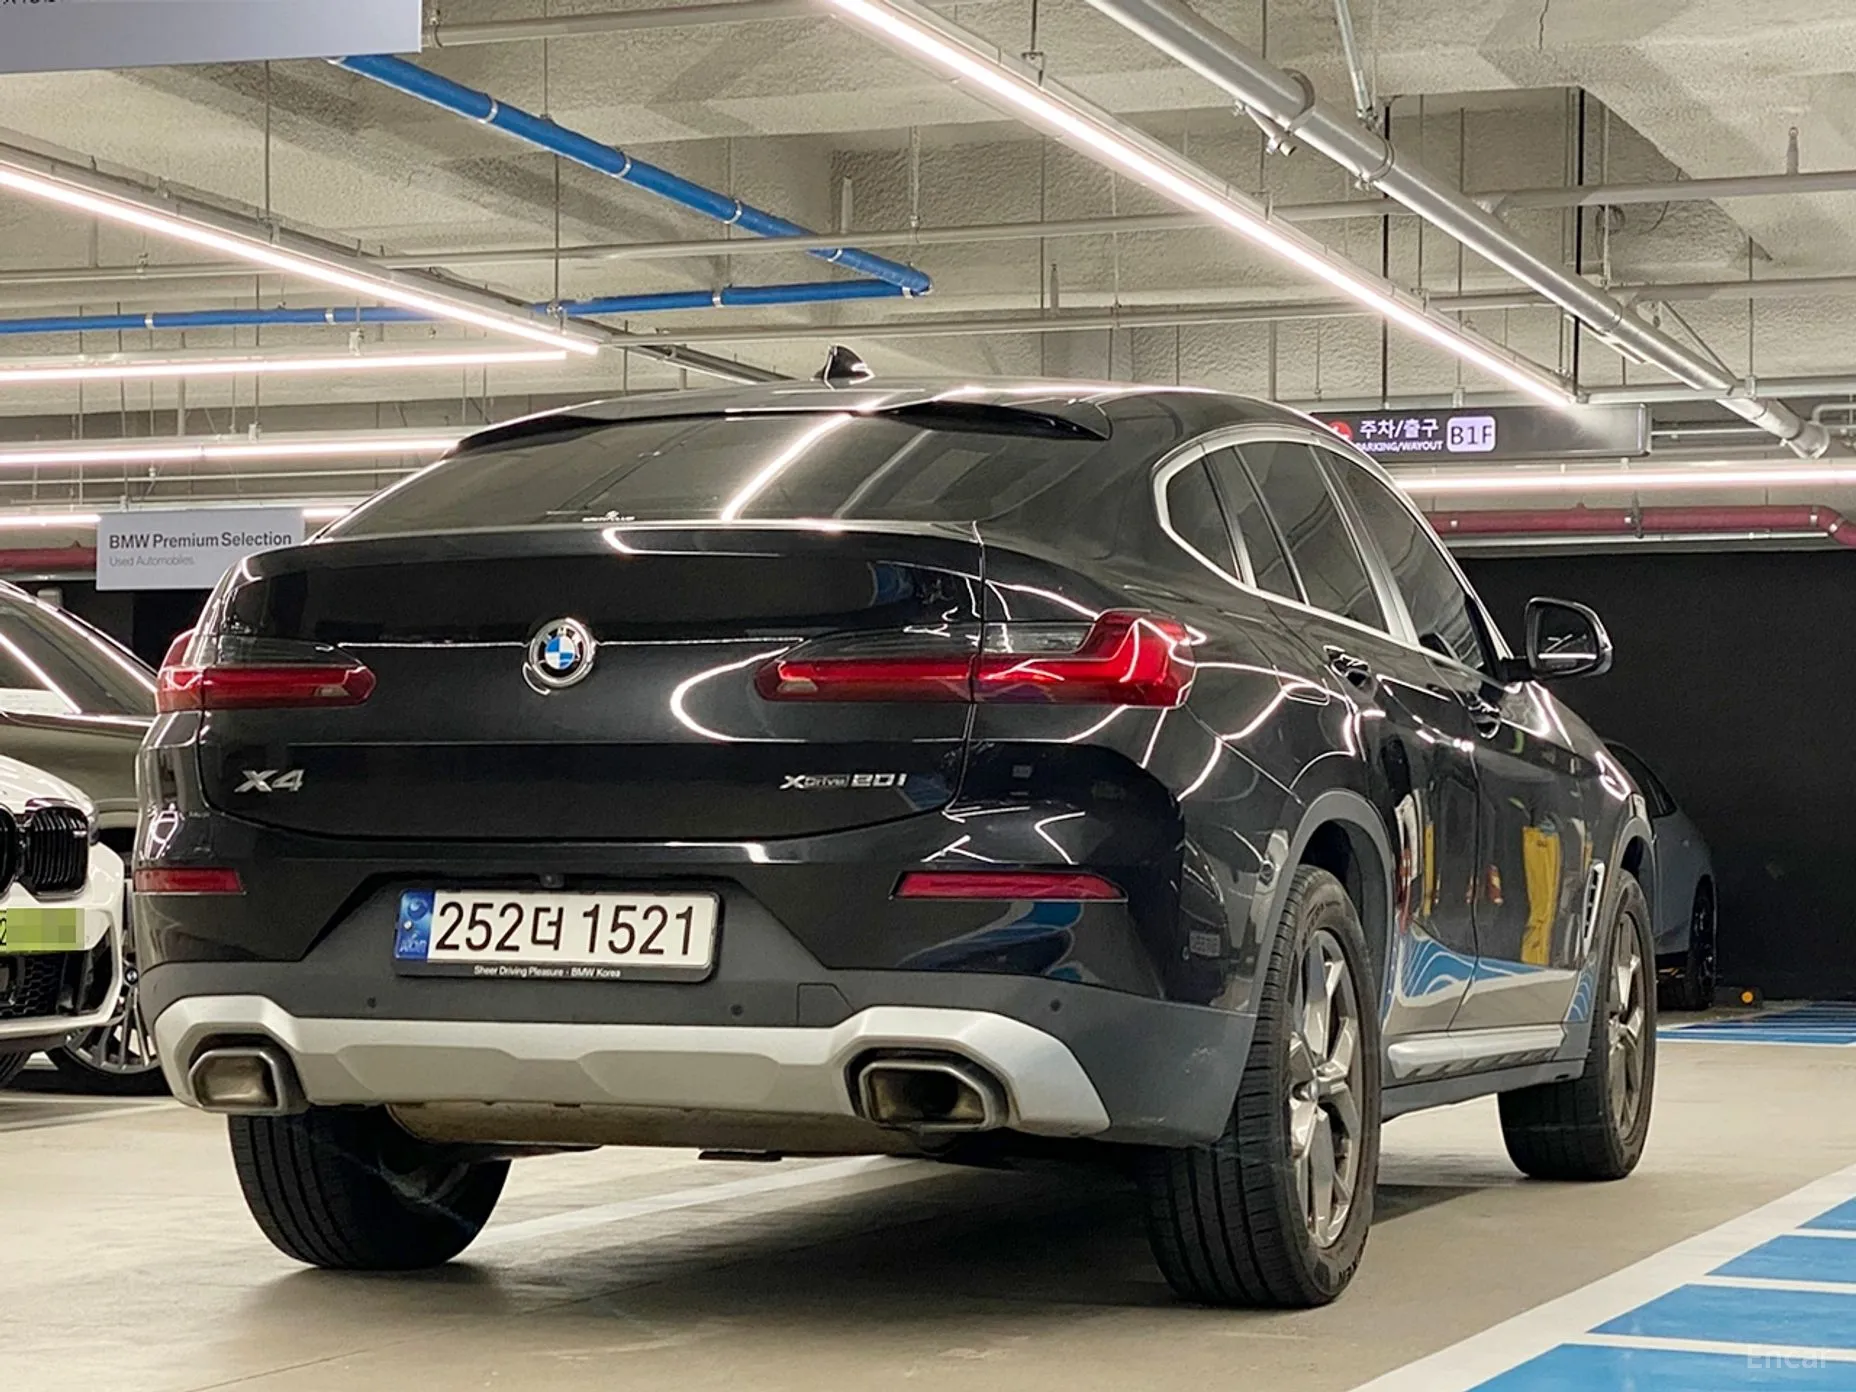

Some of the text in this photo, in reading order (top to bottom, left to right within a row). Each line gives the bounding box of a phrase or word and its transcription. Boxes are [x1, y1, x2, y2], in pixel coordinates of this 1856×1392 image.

[1359, 418, 1439, 439] 주차/출구
[1450, 425, 1492, 446] B1F
[109, 531, 292, 549] BMW Premium Selection
[109, 553, 195, 566] Used Automobiles
[233, 769, 305, 793] X4
[435, 901, 694, 956] 252더 1521
[474, 965, 621, 978] Sheer Driving Pleasure BMW Korea
